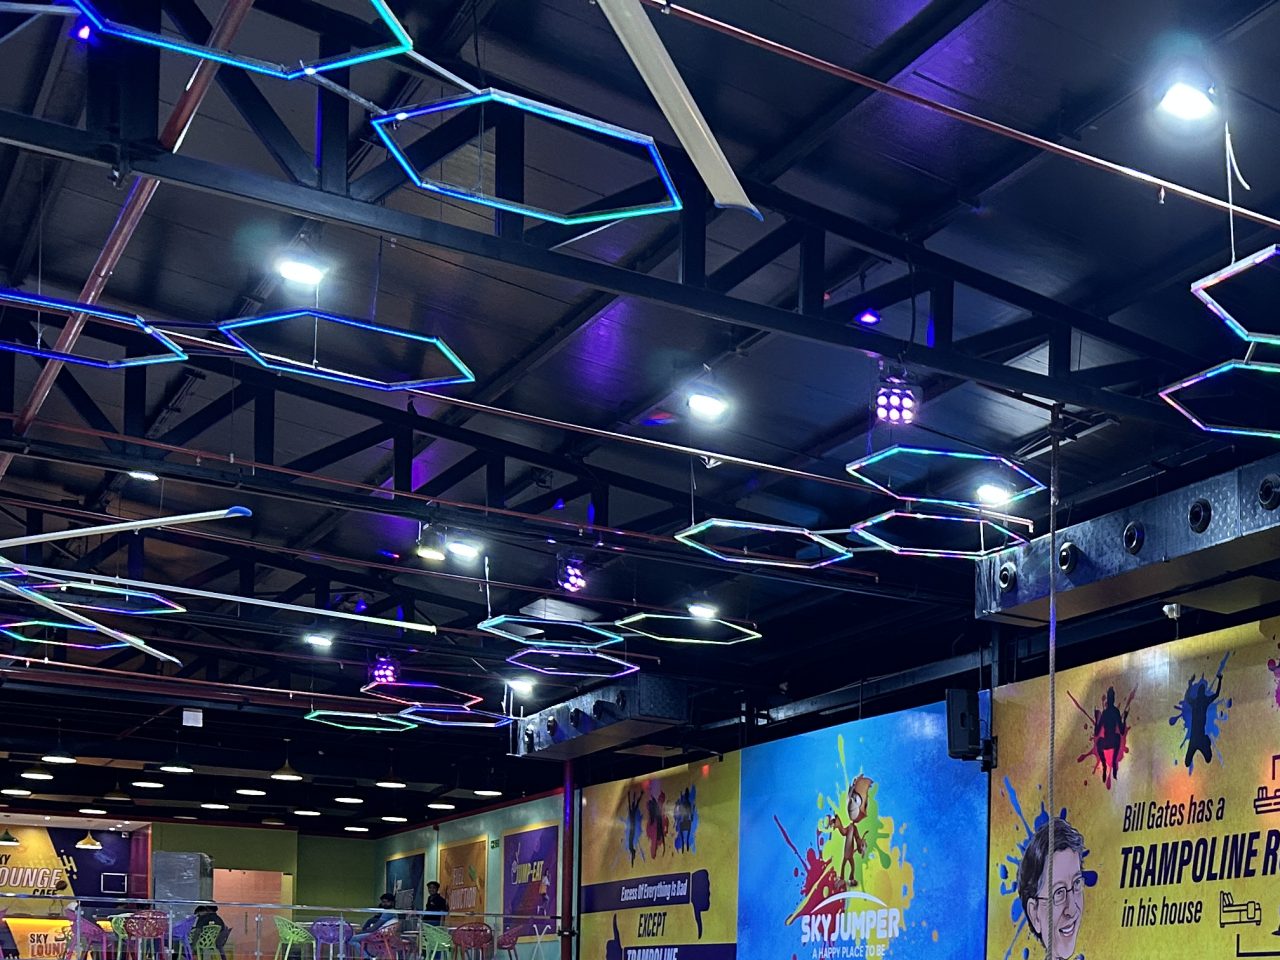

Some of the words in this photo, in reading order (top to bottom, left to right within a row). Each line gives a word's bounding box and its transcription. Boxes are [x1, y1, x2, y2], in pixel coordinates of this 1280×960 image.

[1122, 801, 1146, 832] Bill
[1147, 801, 1184, 830] Gates
[1187, 795, 1211, 825] has
[1215, 797, 1225, 821] a
[1120, 831, 1260, 888] TRAMPOLINE
[0, 866, 62, 888] OUNGE
[620, 886, 638, 901] Excess
[1121, 899, 1135, 927] in
[1137, 897, 1157, 926] his
[1160, 896, 1203, 925] house
[637, 912, 667, 938] EXCEPT
[801, 908, 900, 943] SKYJUMPER
[29, 933, 49, 944] SKY
[30, 943, 66, 958] LOUN
[812, 948, 818, 959] A
[818, 947, 841, 959] HAPPY
[841, 945, 864, 958] PLACE
[865, 945, 876, 957] TO
[876, 944, 886, 956] BE
